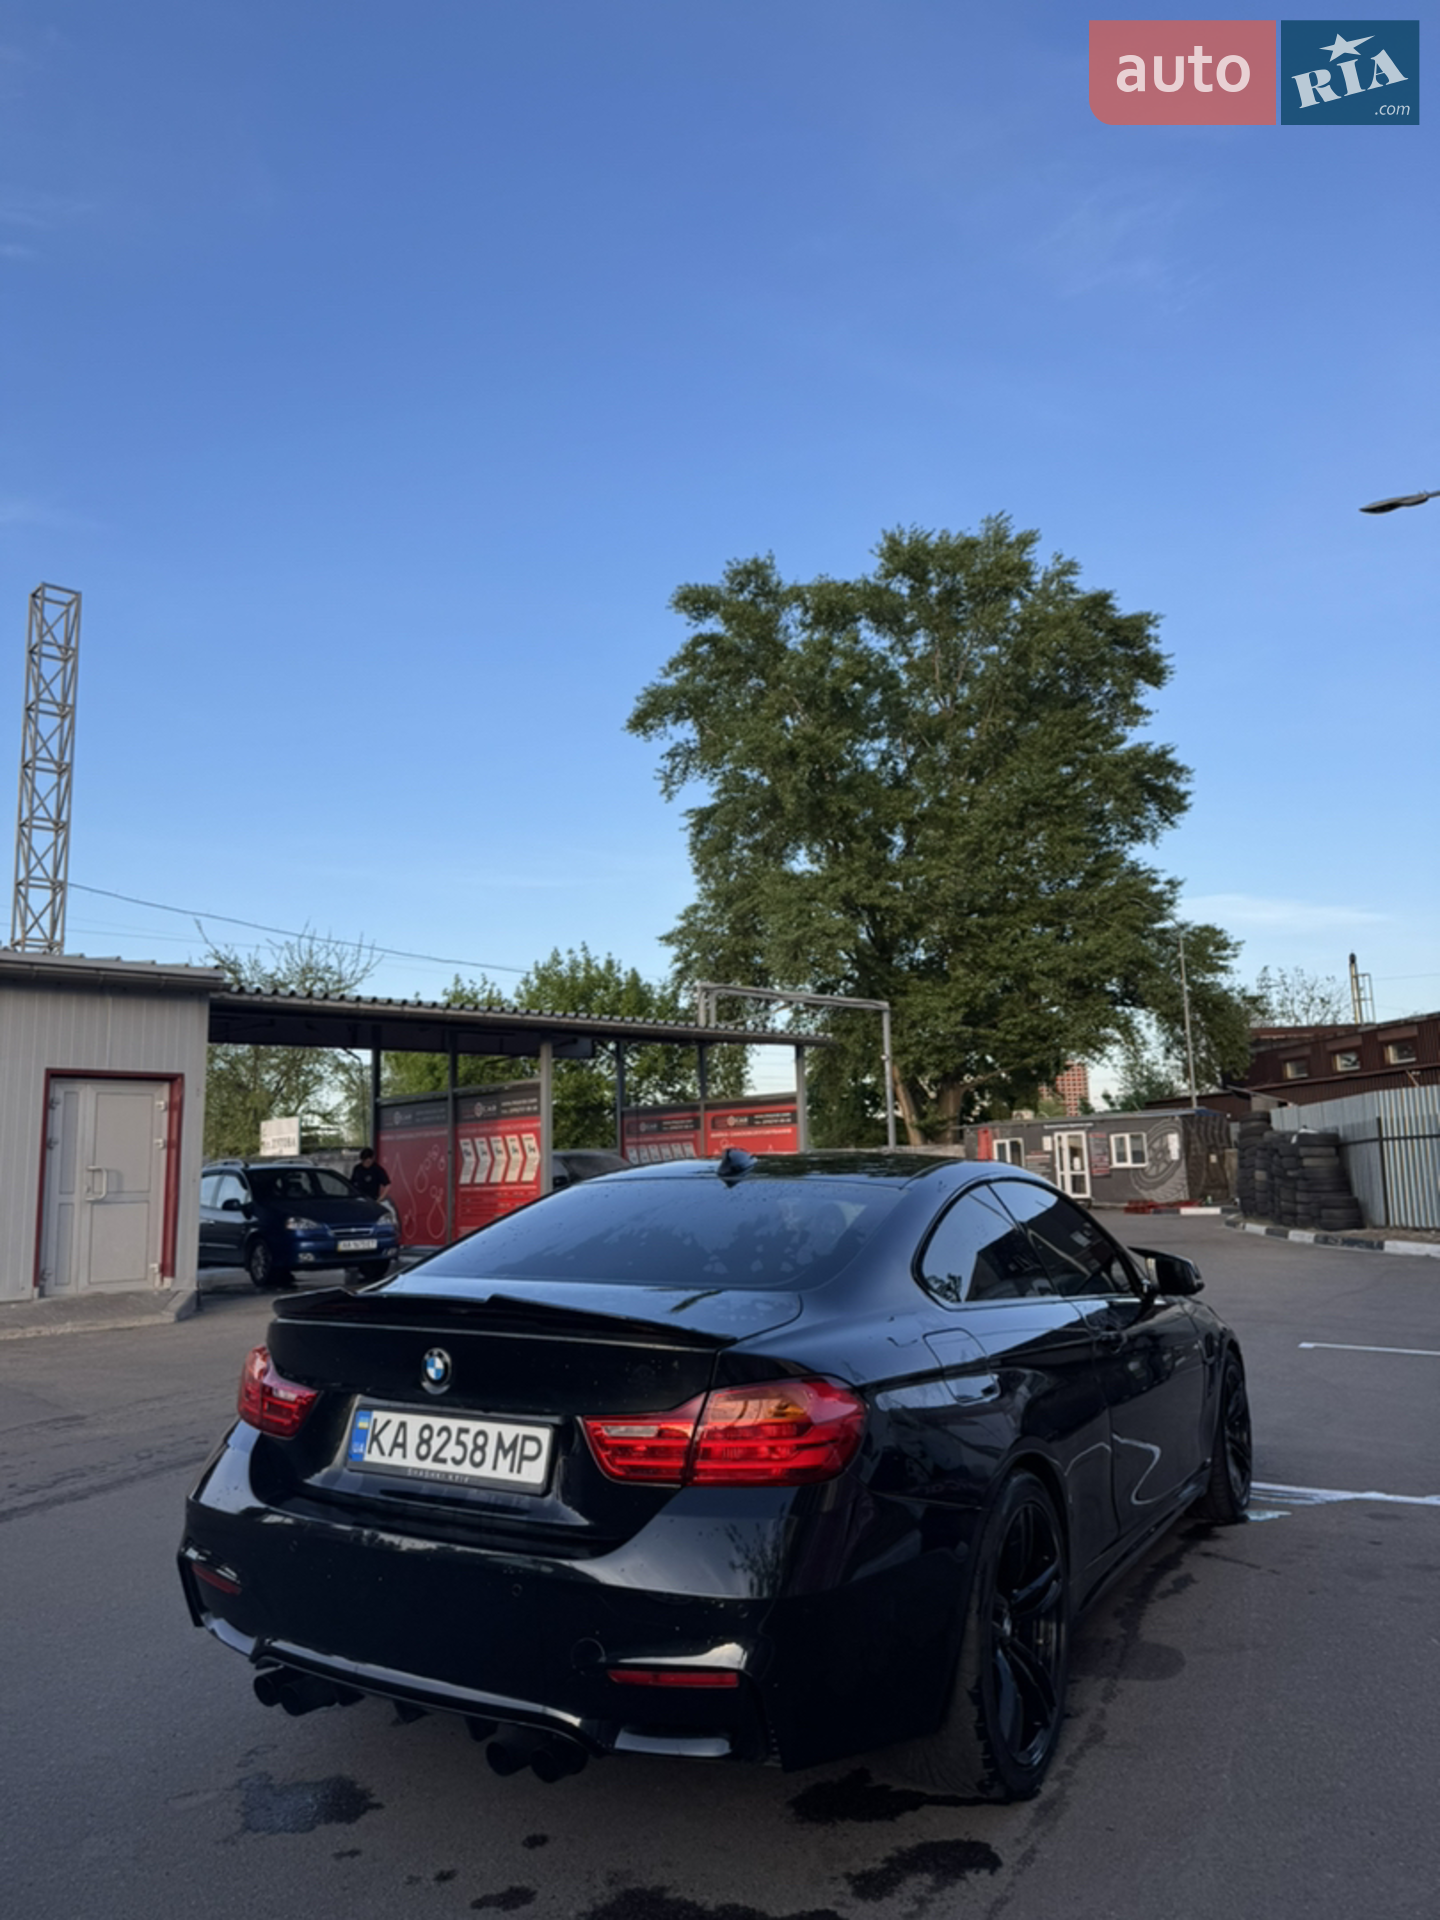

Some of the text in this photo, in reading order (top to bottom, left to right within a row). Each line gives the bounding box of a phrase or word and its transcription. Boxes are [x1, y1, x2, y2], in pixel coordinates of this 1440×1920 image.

[367, 1418, 543, 1475] KA 8258 MP
